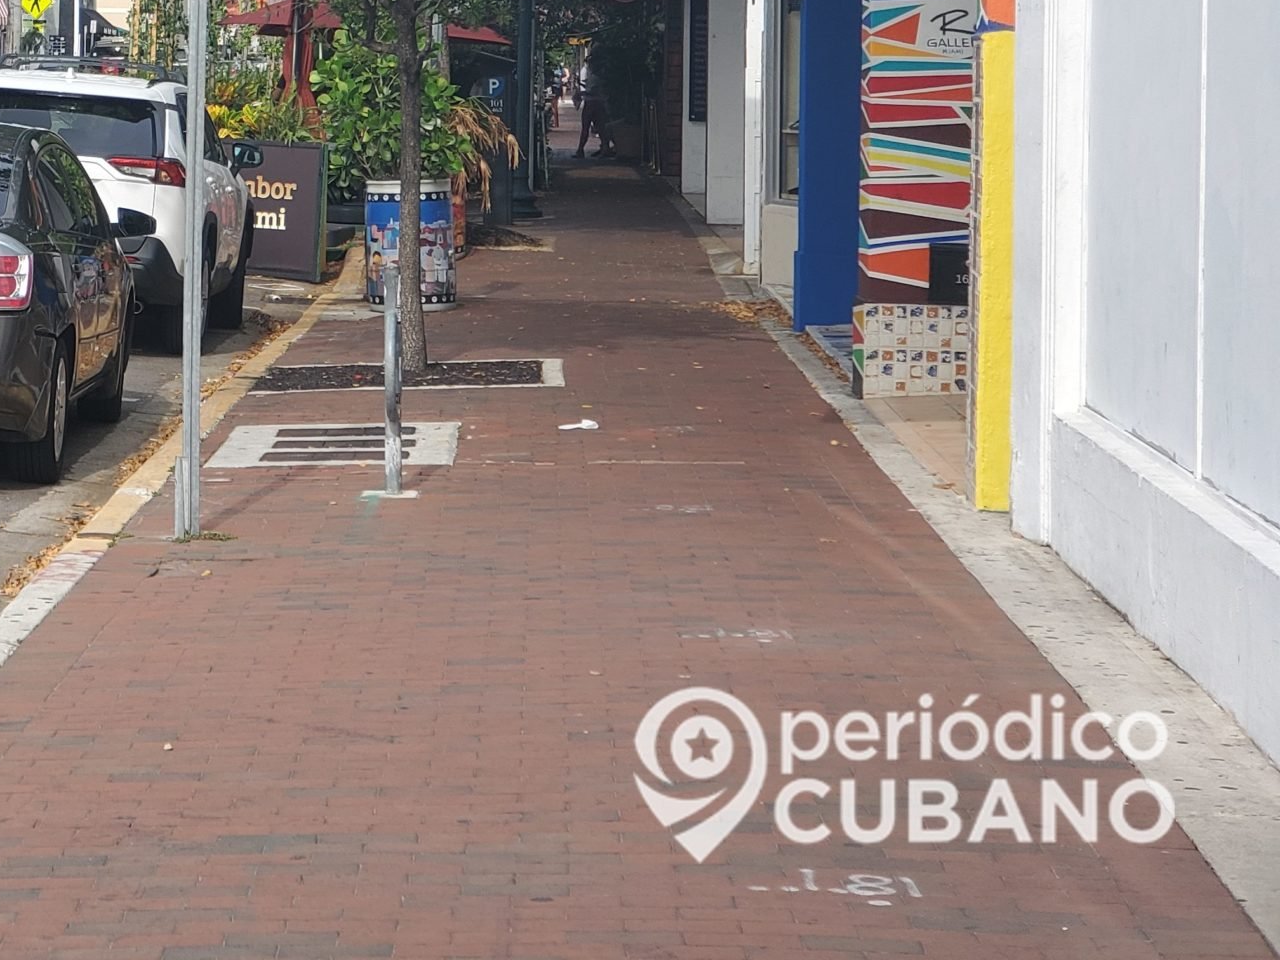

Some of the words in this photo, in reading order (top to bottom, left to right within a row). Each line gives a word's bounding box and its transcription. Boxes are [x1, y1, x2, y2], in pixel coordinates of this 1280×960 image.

[930, 9, 977, 35] R
[488, 78, 500, 95] P
[490, 99, 503, 107] 101
[246, 176, 297, 200] abor
